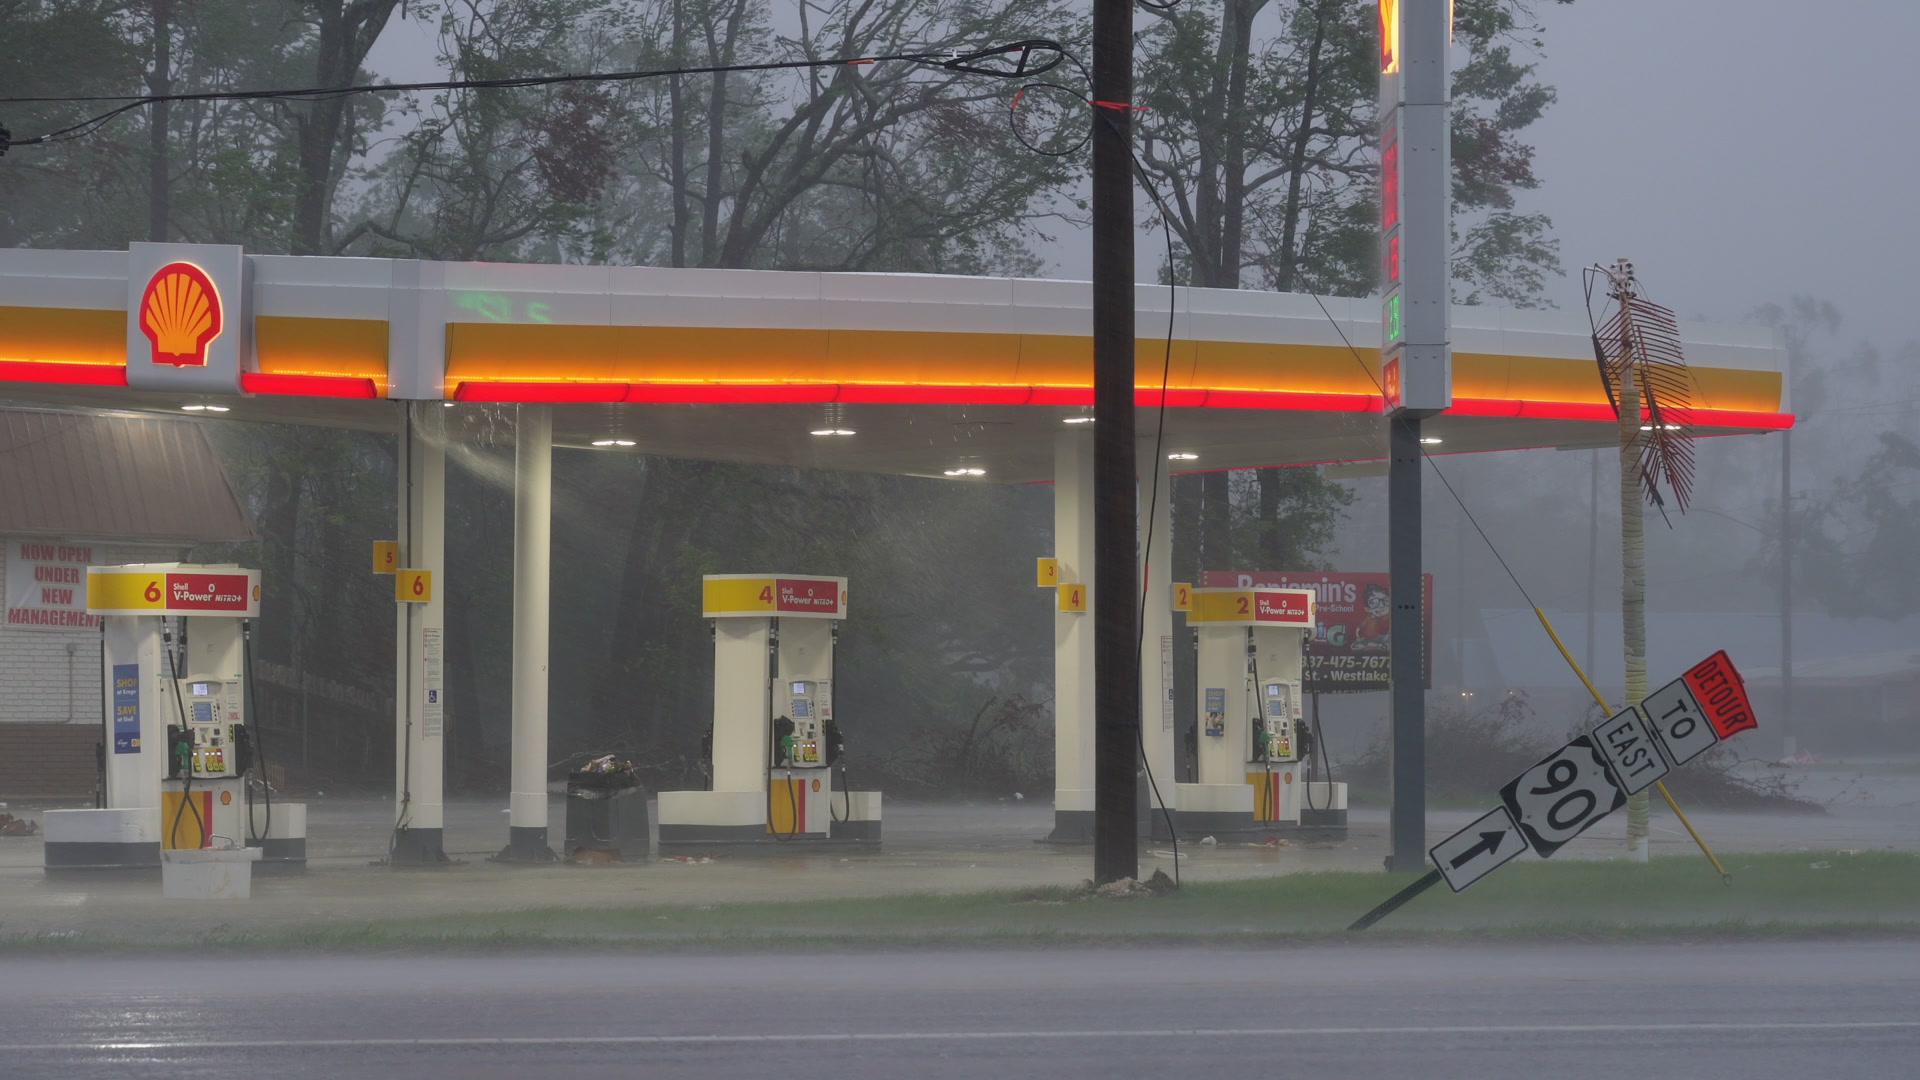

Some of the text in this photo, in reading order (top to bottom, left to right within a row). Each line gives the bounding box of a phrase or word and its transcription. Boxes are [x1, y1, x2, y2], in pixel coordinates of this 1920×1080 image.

[21, 544, 92, 563] NOW OPEN
[386, 552, 393, 564] 5
[34, 566, 80, 584] UNDER
[1048, 566, 1054, 576] 3
[144, 581, 162, 603] 6
[173, 583, 188, 591] Shell
[413, 575, 424, 596] 6
[782, 587, 793, 595] Shell
[41, 588, 73, 605] NEW
[173, 591, 212, 602] V-Power
[759, 585, 773, 605] 4
[782, 595, 811, 605] V-Power
[1071, 590, 1079, 607] 4
[1180, 588, 1187, 605] 2
[1237, 596, 1249, 614] 2
[1260, 606, 1285, 615] V-Power
[1693, 660, 1748, 730] DETOUR
[1661, 699, 1696, 739] TO
[1606, 721, 1656, 778] EAST
[1529, 759, 1597, 830] 90
